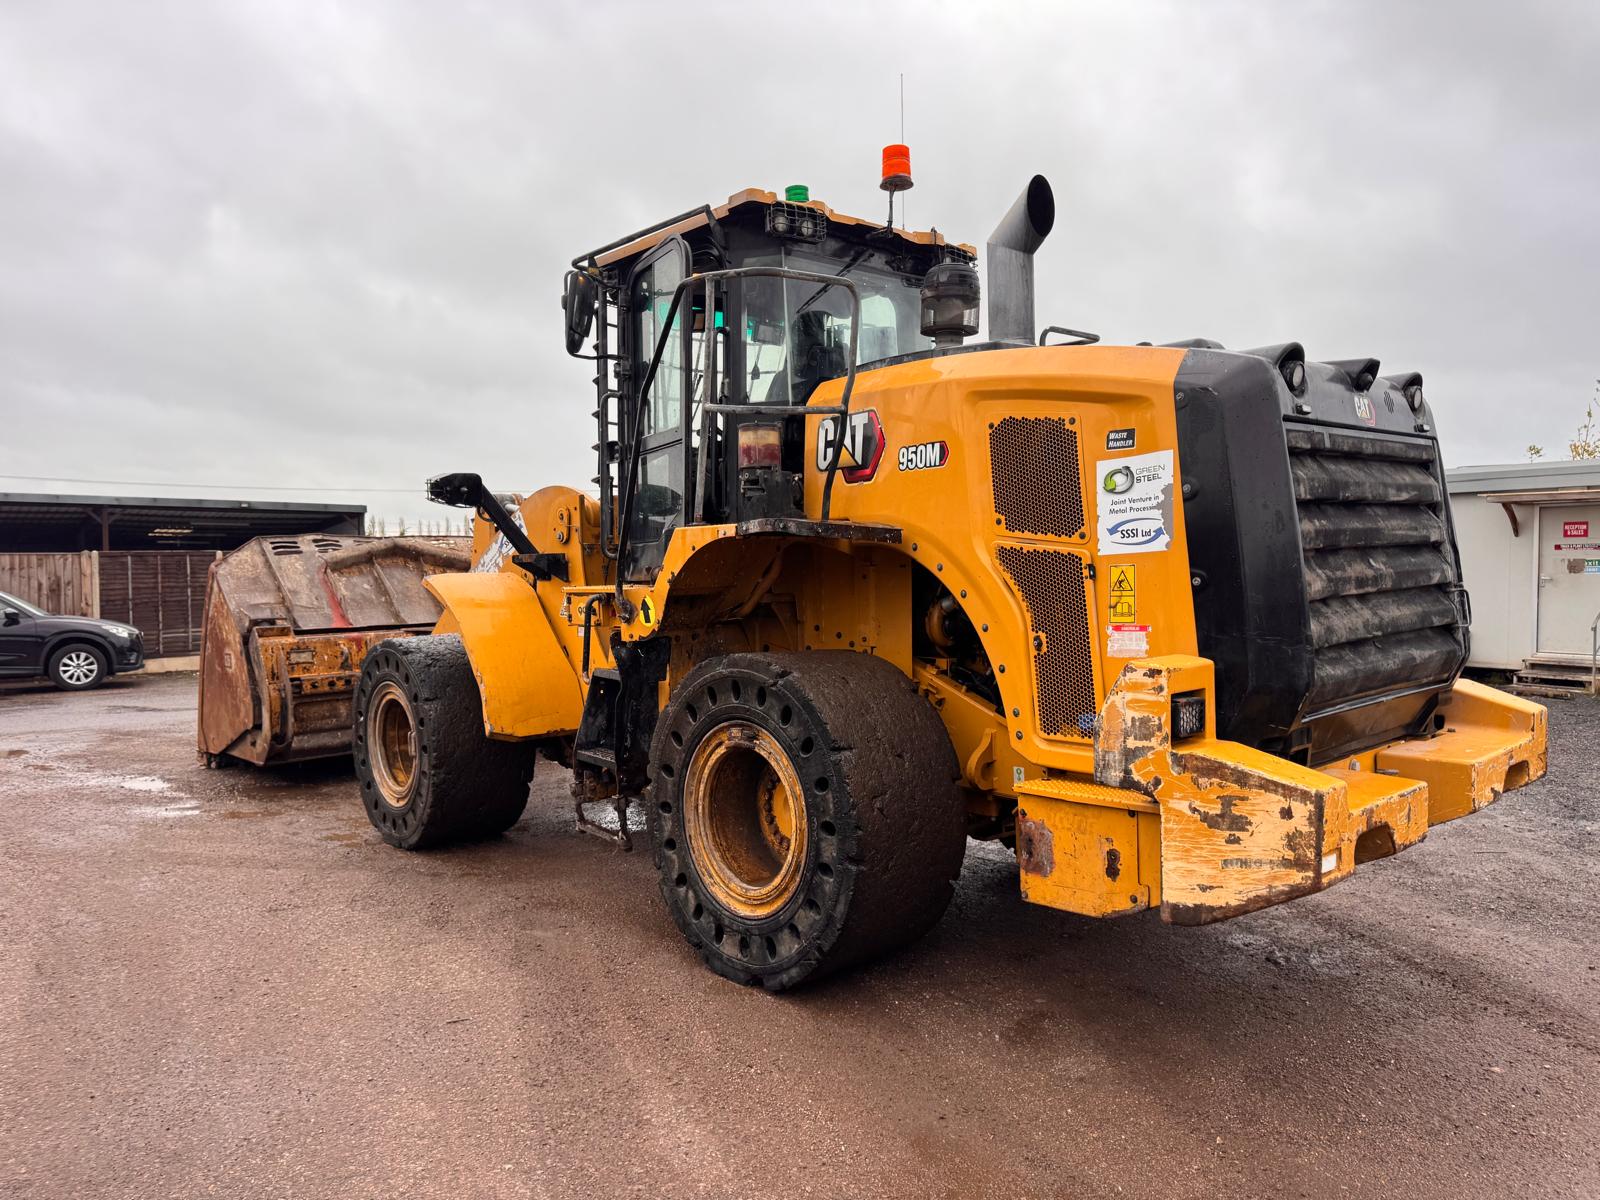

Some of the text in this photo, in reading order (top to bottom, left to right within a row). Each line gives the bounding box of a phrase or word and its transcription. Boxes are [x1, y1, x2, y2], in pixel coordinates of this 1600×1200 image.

[899, 442, 940, 470] 950M
[1135, 464, 1165, 475] GREEN
[1135, 473, 1162, 484] STEEL
[1110, 497, 1127, 506] Joint
[1128, 495, 1152, 504] Venture
[1108, 506, 1128, 515] Metal
[1120, 528, 1152, 539] SSSI Ltd
